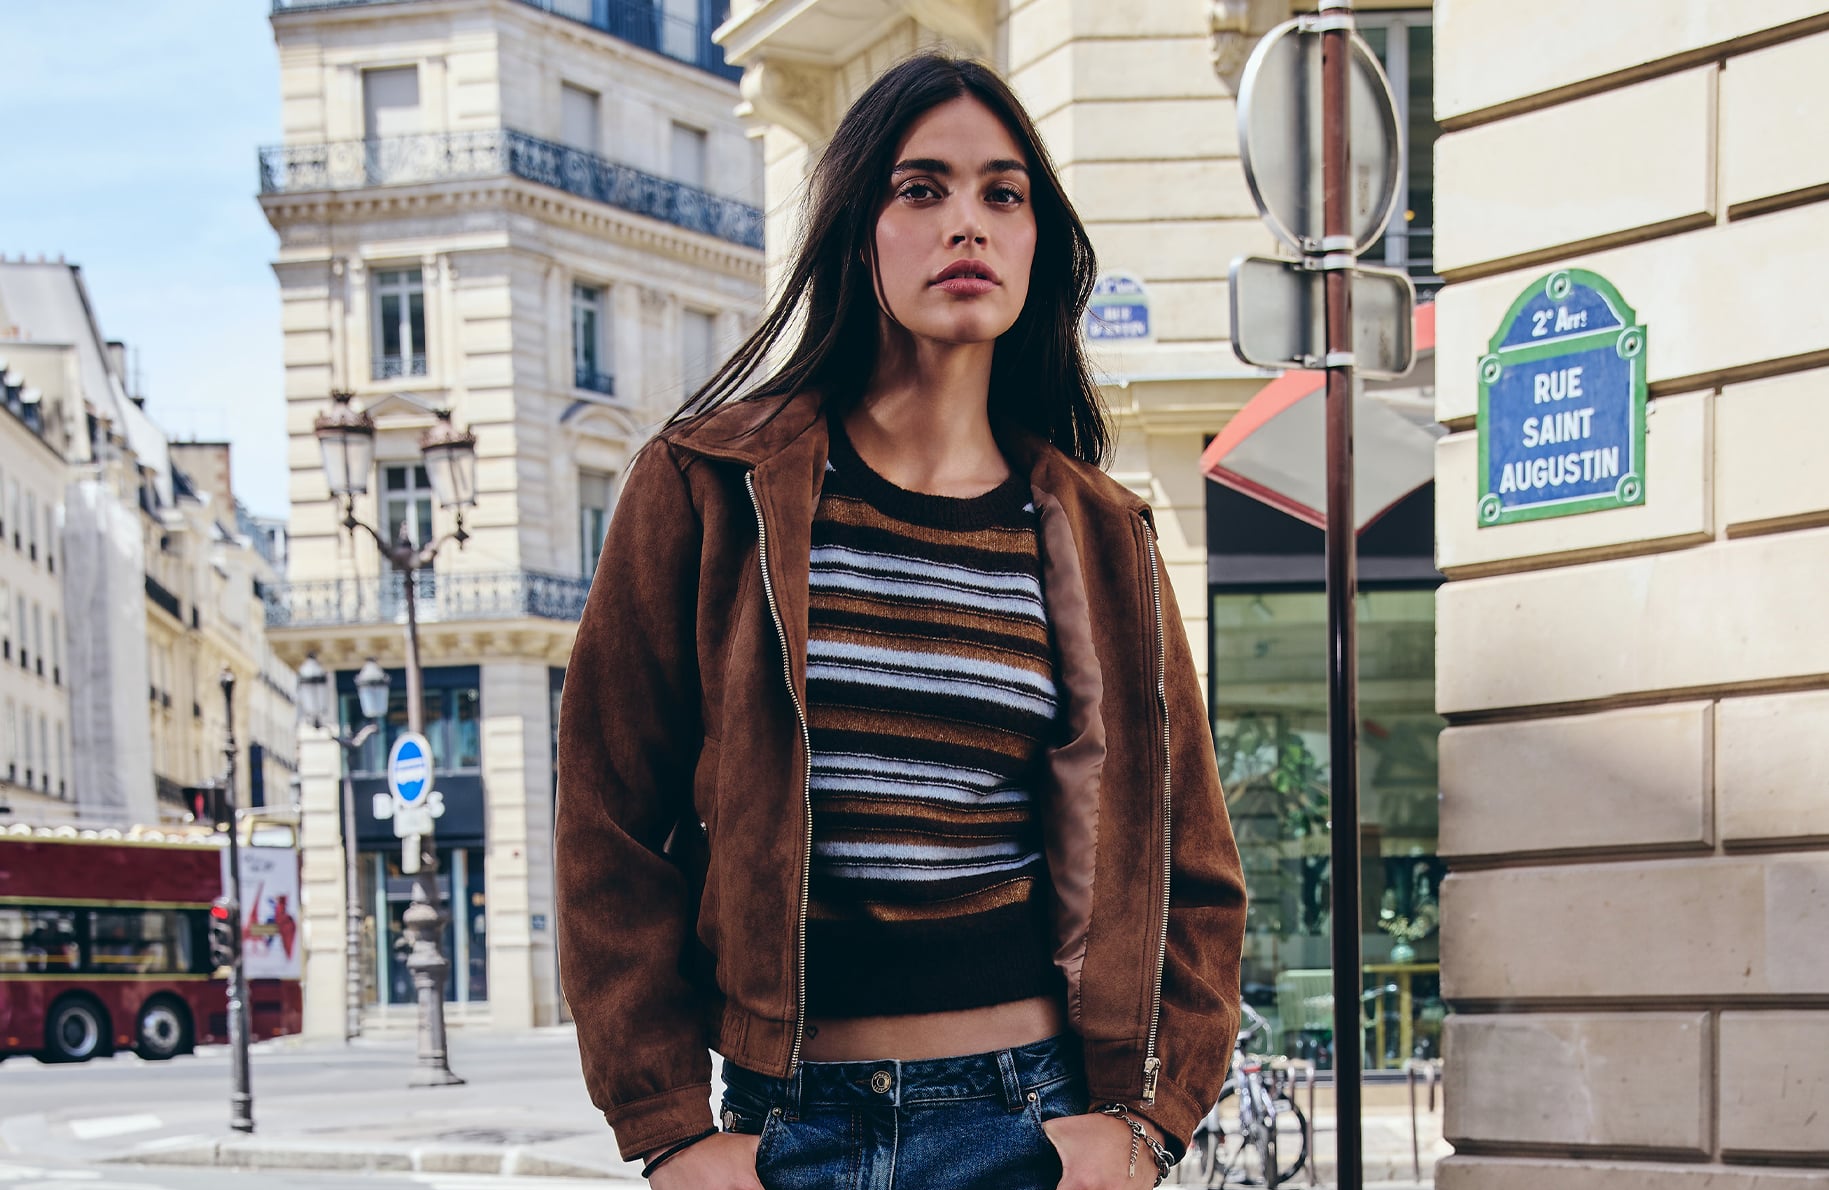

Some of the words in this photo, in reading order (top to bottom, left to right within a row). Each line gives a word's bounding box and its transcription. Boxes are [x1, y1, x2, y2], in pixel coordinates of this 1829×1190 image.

[1534, 367, 1583, 404] RUE
[1522, 408, 1594, 448] SAINT
[1499, 446, 1619, 495] AUGUSTIN
